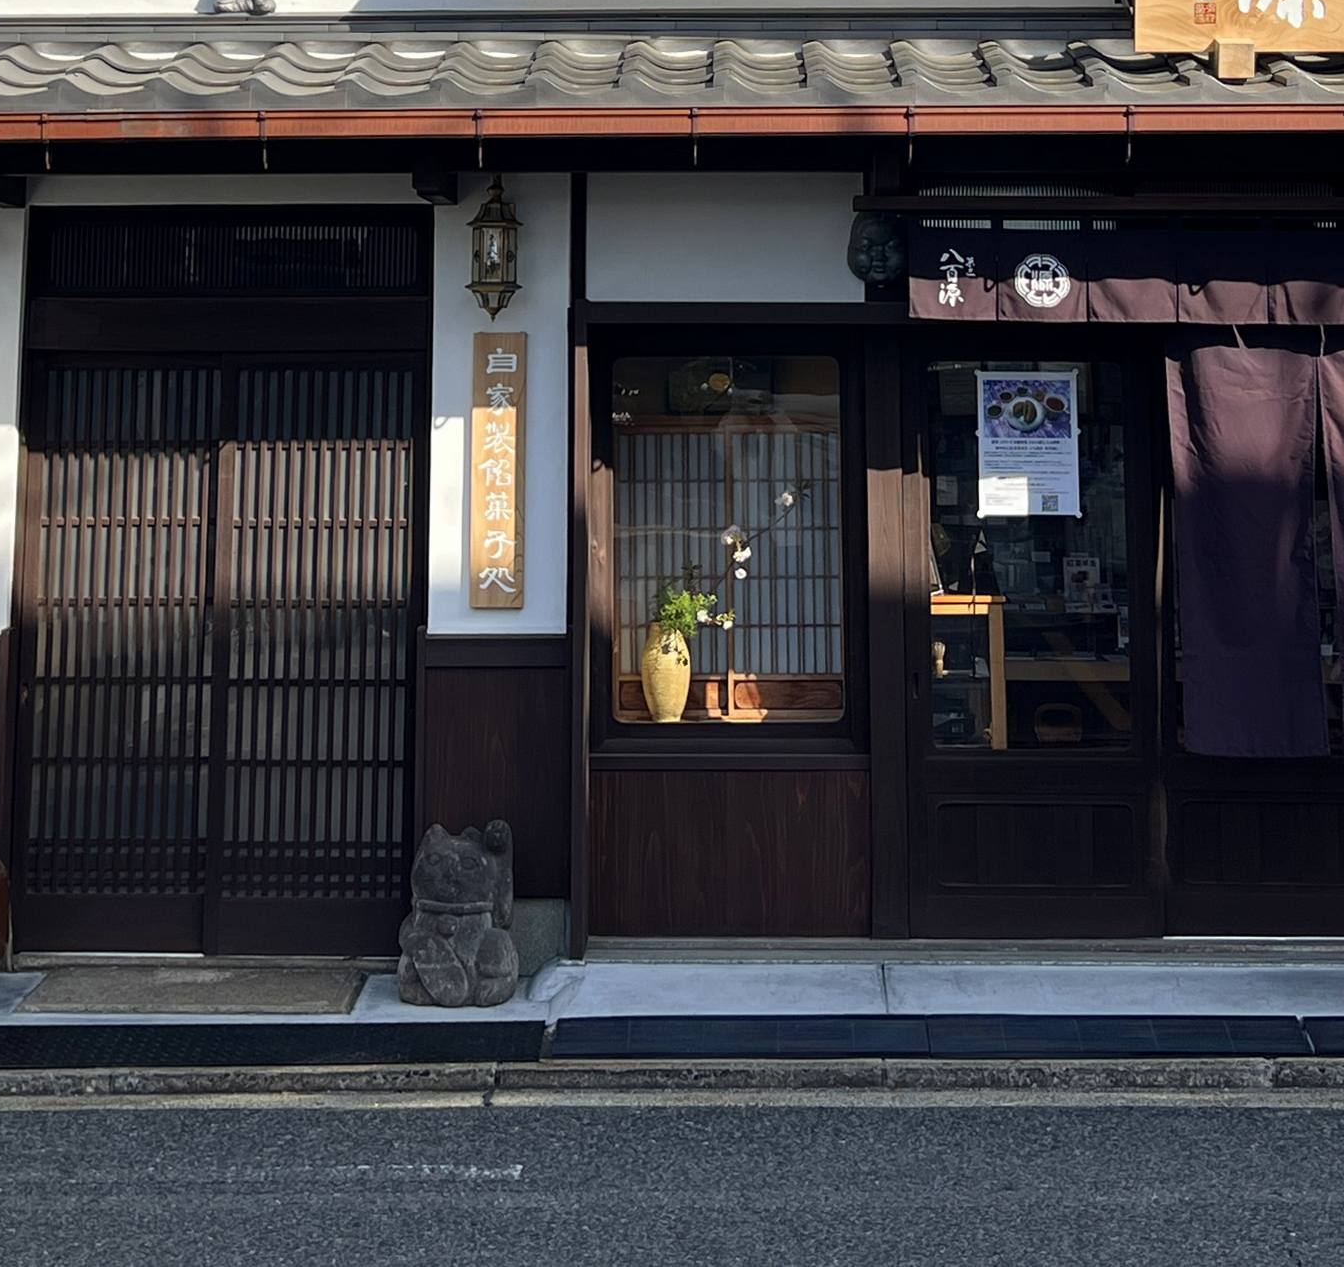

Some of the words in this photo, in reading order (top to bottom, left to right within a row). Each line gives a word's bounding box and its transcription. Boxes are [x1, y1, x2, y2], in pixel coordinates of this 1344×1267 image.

[938, 247, 966, 308] 八百源
[476, 346, 518, 595] 自家製餡菓子処
